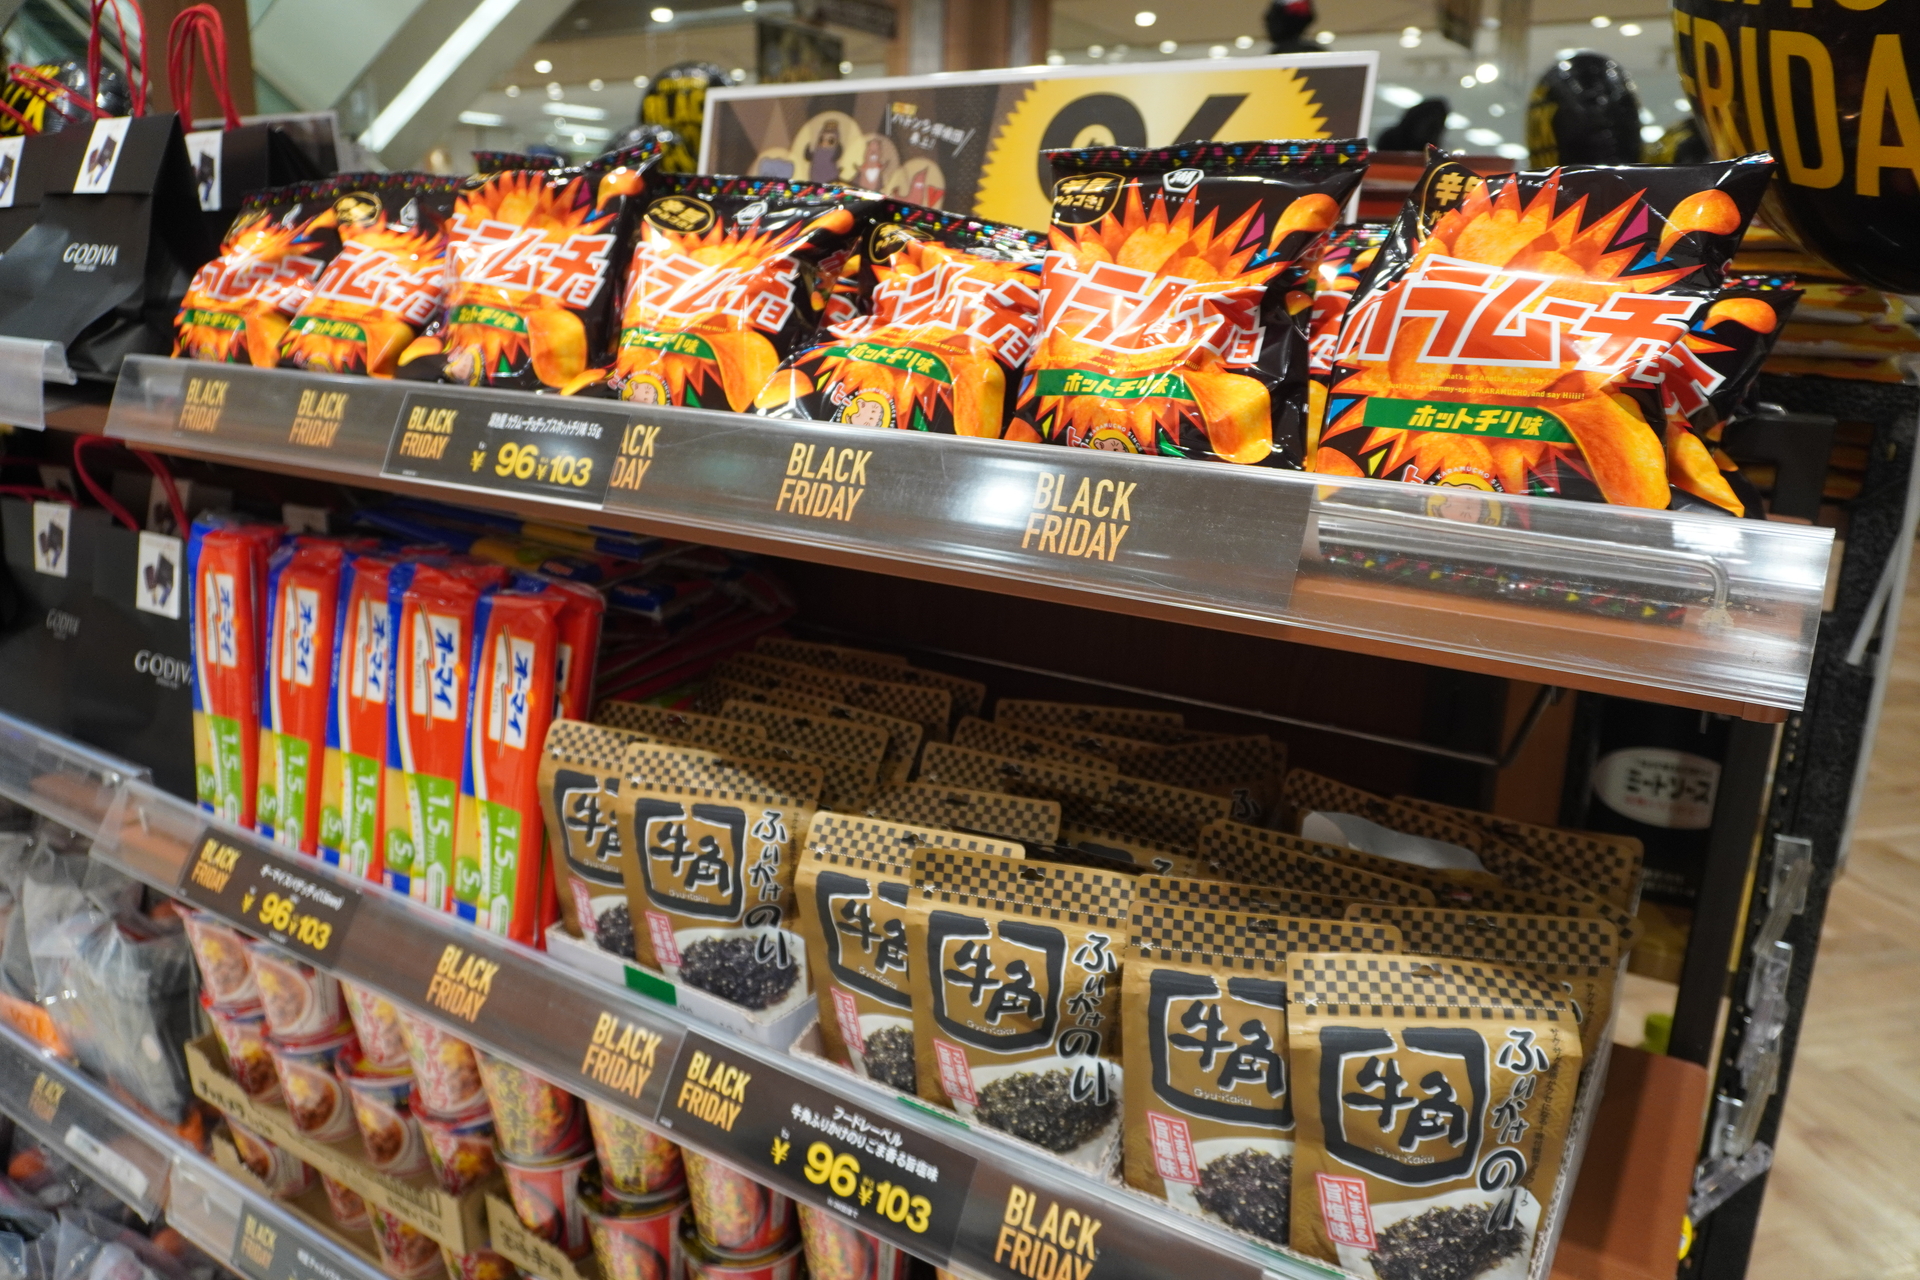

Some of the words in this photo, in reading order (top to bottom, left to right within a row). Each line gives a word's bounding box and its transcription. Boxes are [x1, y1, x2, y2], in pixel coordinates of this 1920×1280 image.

[1499, 177, 1565, 192] KOIKEYA
[63, 242, 119, 266] GODIVA
[620, 329, 700, 356] ホットチリ味
[848, 343, 936, 374] ホットチリ味
[187, 377, 229, 408] BLACK
[297, 389, 350, 420] BLACK
[1062, 372, 1171, 398] ホットチリ味
[1530, 390, 1546, 398] and
[1547, 391, 1561, 400] say
[179, 404, 223, 433] FRIDAY
[289, 418, 341, 449] FRIDAY
[406, 405, 459, 434] BLACK
[1088, 422, 1128, 437] KARAMUCHO
[1407, 404, 1544, 437] ホットチリ味
[399, 431, 451, 461] FRIDAY
[495, 441, 540, 480] 96
[785, 442, 873, 486] BLACK
[1031, 470, 1138, 522] BLACK
[1434, 465, 1491, 481] KARAMUCHO
[775, 475, 865, 523] FRIDAY
[1021, 512, 1130, 563] FRIDAY
[368, 612, 387, 693] オーマイ
[433, 626, 455, 711] オーマイ
[507, 650, 530, 740] オーマイ
[201, 838, 242, 874] BLACK
[424, 795, 453, 872] 1.5mm
[649, 820, 734, 897] 牛角
[190, 859, 232, 895] FRIDAY
[488, 822, 517, 896] 1.5mm
[258, 891, 295, 932] 96
[436, 943, 500, 993] BLACK
[942, 938, 1045, 1025] 牛角
[425, 973, 489, 1023] FRIDAY
[592, 1009, 664, 1067] BLACK
[1167, 999, 1287, 1099] 牛角
[580, 1042, 654, 1100] FRIDAY
[687, 1050, 752, 1104] BLACK
[676, 1080, 742, 1133] FRIDAY
[832, 1104, 904, 1148] フードレーベル
[1344, 1055, 1469, 1152] 牛角
[770, 1135, 791, 1166] ¥
[803, 1140, 861, 1198] 96
[1153, 1118, 1178, 1178] 旨塩味
[1172, 1124, 1194, 1179] ごま香る
[1002, 1184, 1103, 1263] BLACK
[1321, 1177, 1352, 1242] 旨塩味
[1345, 1182, 1369, 1244] ごま香る
